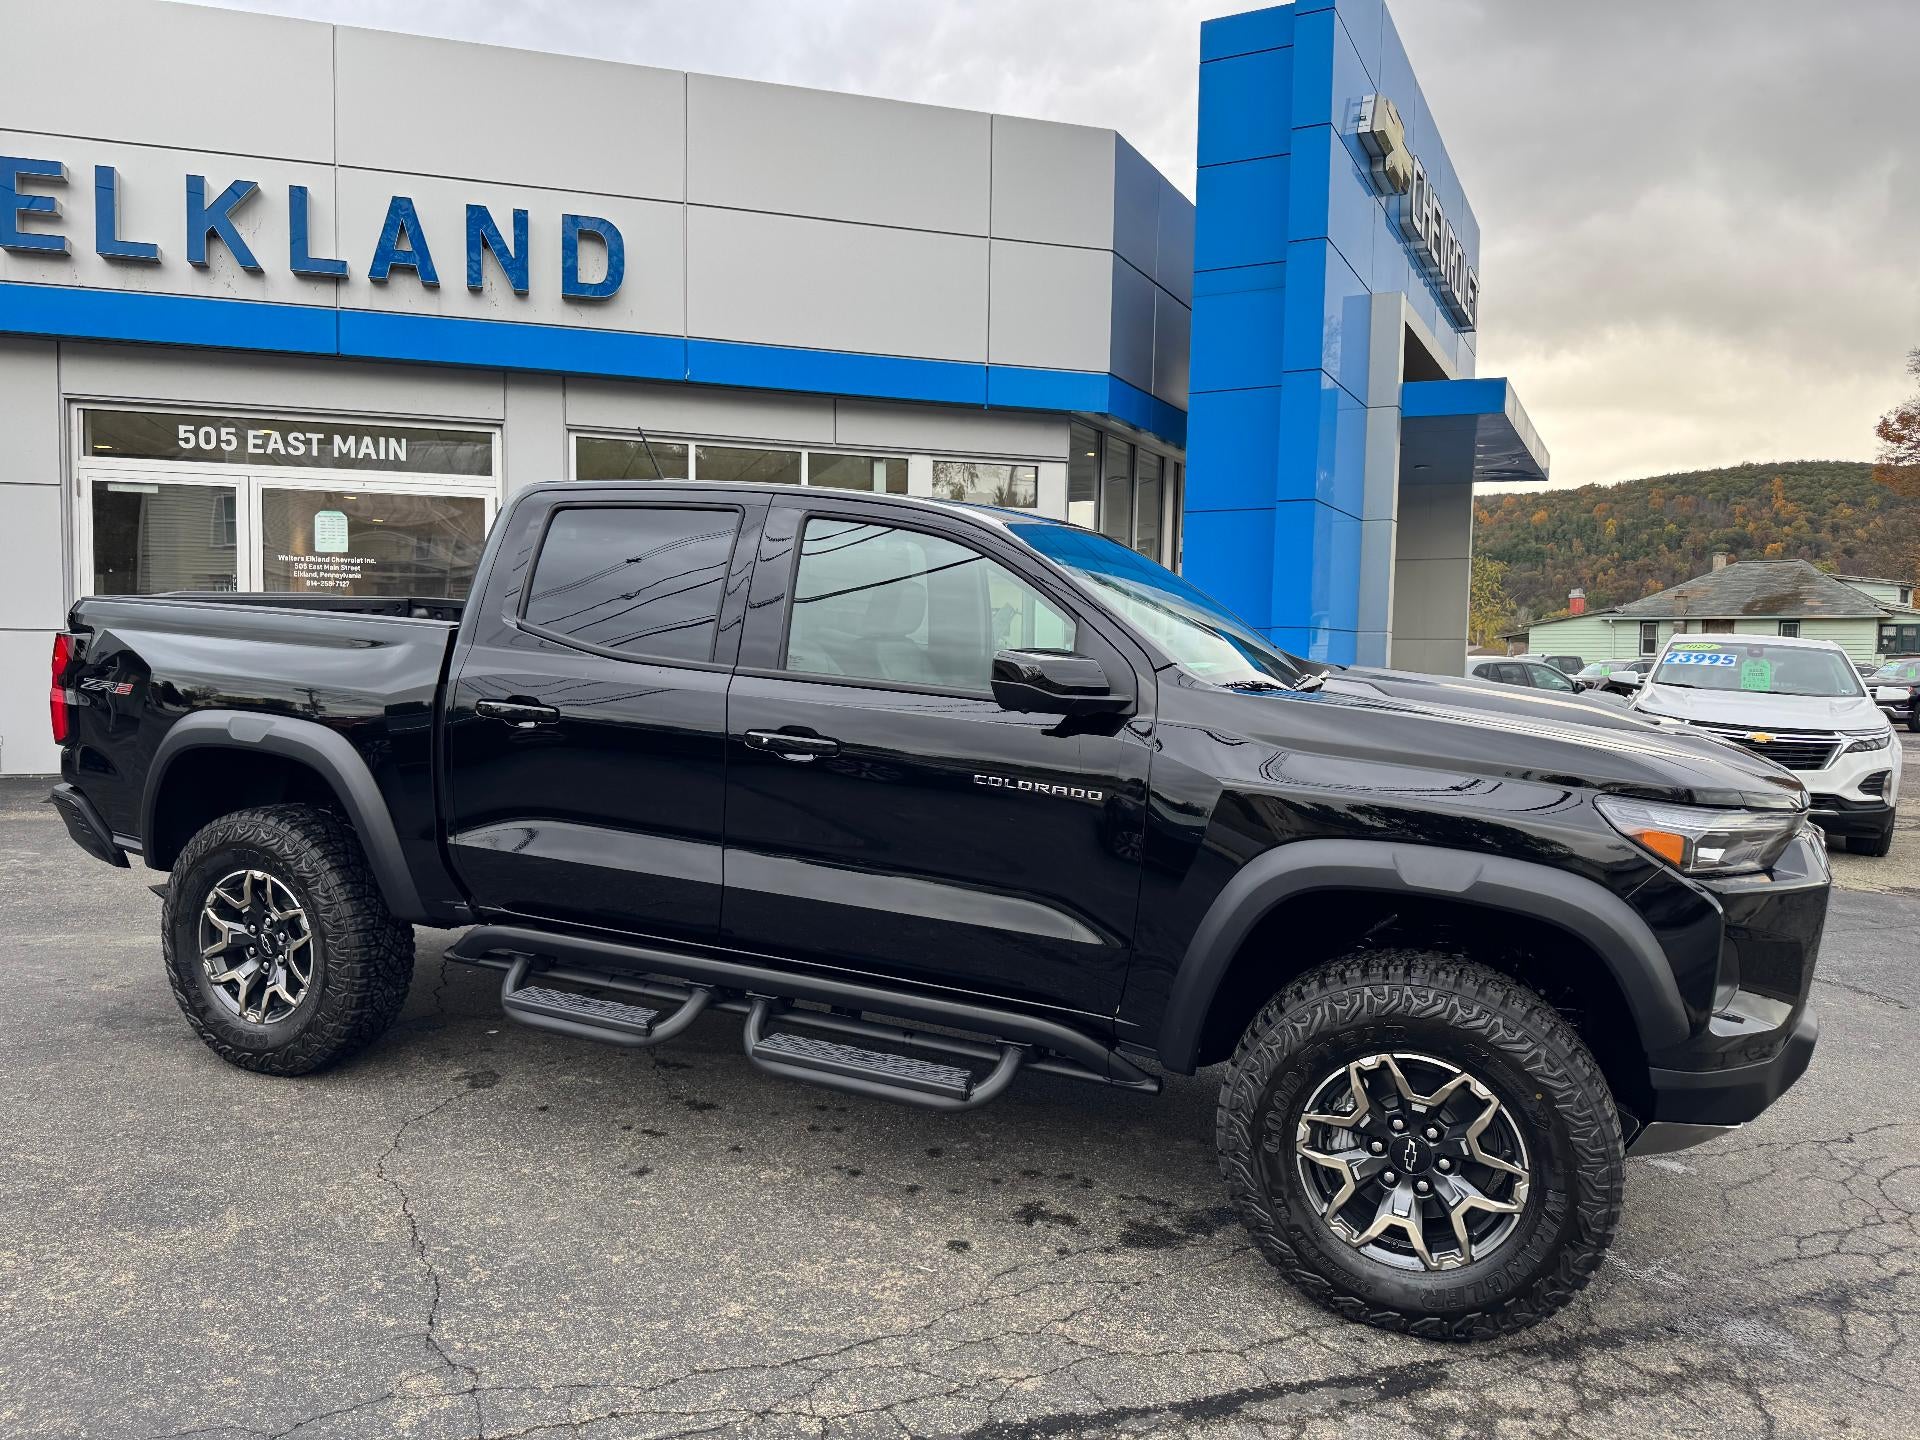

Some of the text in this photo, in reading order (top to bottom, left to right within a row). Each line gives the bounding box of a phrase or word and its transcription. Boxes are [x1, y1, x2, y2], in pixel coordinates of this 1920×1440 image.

[0, 155, 627, 302] ELKLAND
[1404, 155, 1481, 332] CHEVROLET
[178, 424, 407, 462] 505 EAST MAIN
[306, 555, 330, 563] Elkland
[308, 563, 322, 571] East
[340, 564, 361, 572] Street
[319, 571, 362, 579] Pennsylvania
[1664, 652, 1736, 665] 23995
[80, 677, 135, 696] ZR2
[973, 774, 1103, 801] COLORADO
